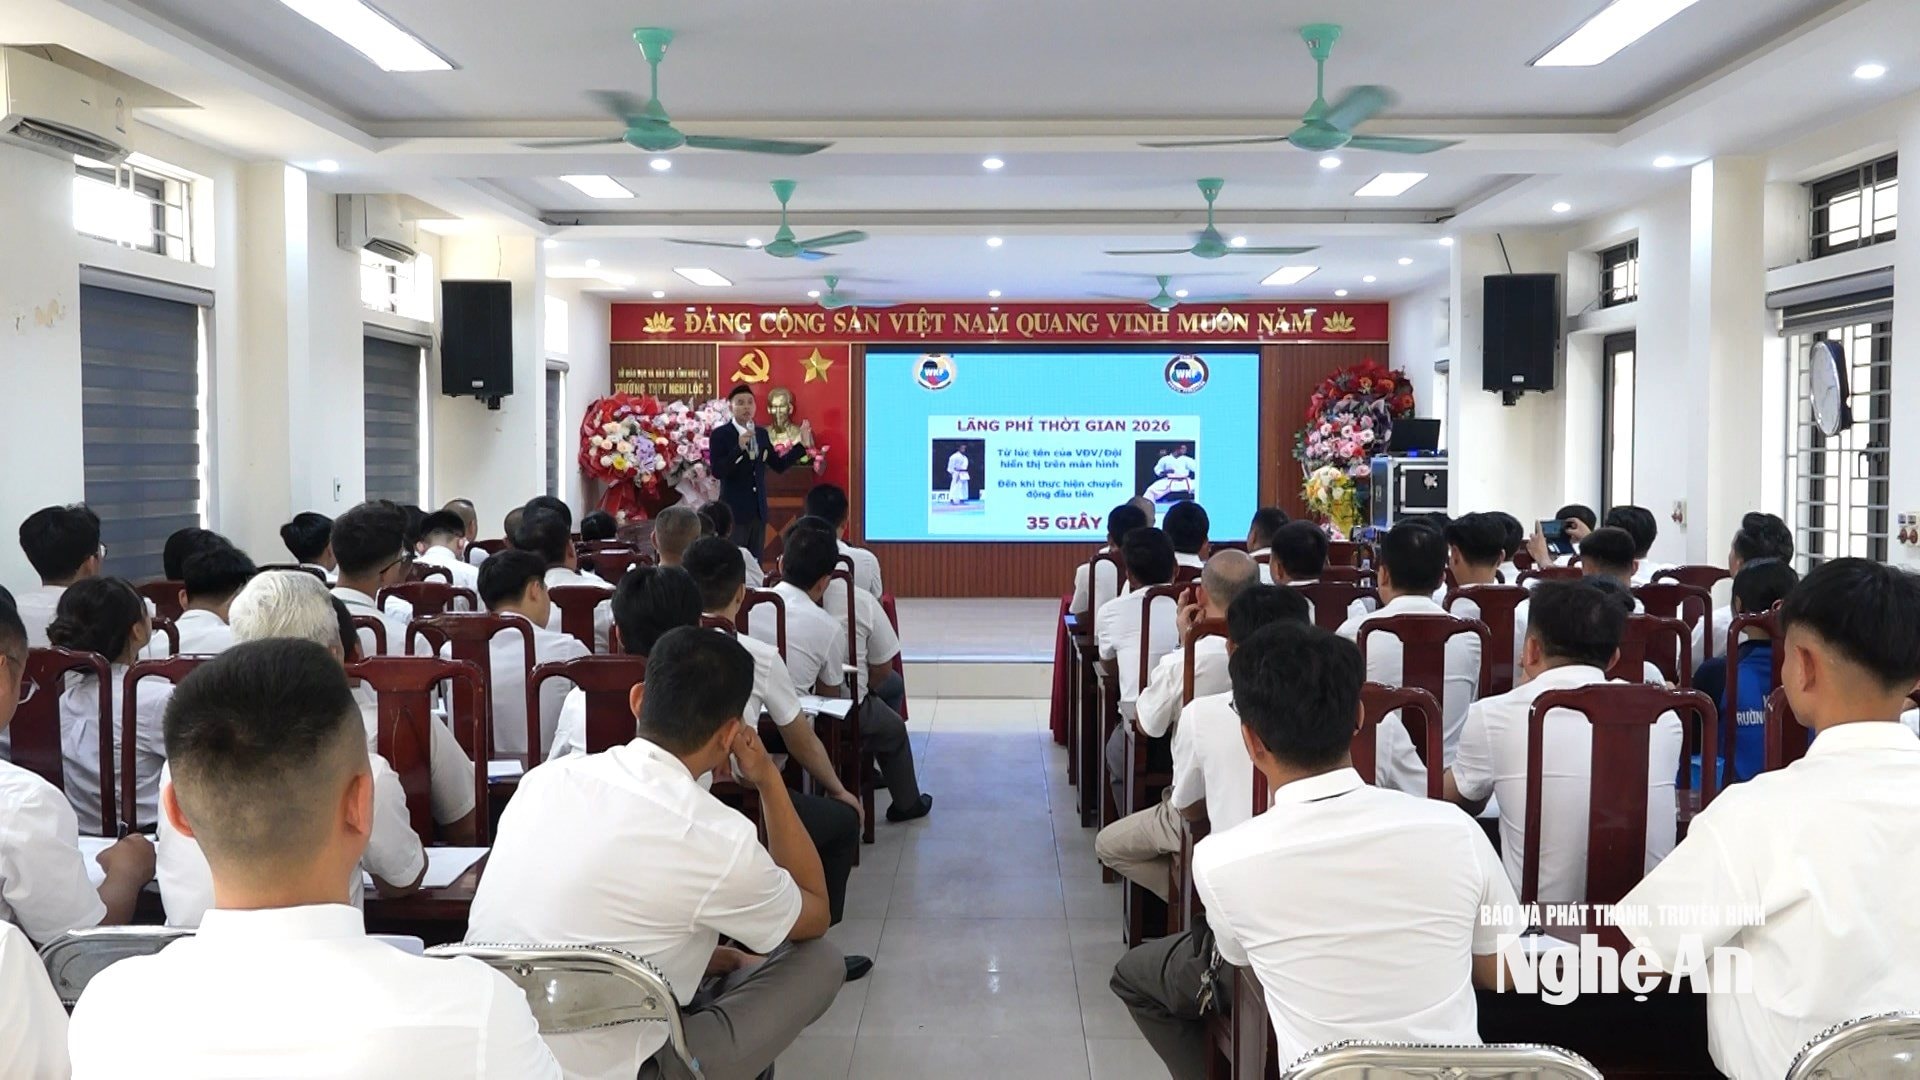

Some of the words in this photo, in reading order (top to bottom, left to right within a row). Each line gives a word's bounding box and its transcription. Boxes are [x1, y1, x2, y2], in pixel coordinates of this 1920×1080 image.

[684, 306, 752, 334] ĐẢNG
[759, 307, 826, 338] CỘNG
[833, 306, 881, 334] SẢN
[888, 307, 946, 338] VIỆT
[953, 313, 1009, 334] NAM
[1016, 313, 1099, 337] QUANG
[1106, 313, 1169, 334] VINH
[1177, 307, 1250, 334] MUÔN
[1257, 307, 1313, 334] NĂM
[648, 383, 667, 395] THPT
[669, 383, 687, 395] NGHI
[688, 381, 704, 398] LỘC
[706, 383, 713, 395] 3
[957, 416, 1000, 432] LÃNG
[1005, 416, 1033, 432] PHÍ
[1039, 416, 1080, 432] THỜI
[1085, 420, 1126, 432] GIAN
[1132, 420, 1171, 432] 2026
[997, 448, 1011, 457] Từ
[1014, 448, 1029, 457] lúc
[1033, 448, 1051, 457] tên
[1053, 448, 1072, 457] của
[1000, 459, 1023, 468] hiển
[1026, 459, 1041, 470] thị
[1044, 459, 1066, 468] trên
[1069, 459, 1092, 468] màn
[1095, 459, 1119, 468] hình
[998, 479, 1017, 488] Đến
[1020, 479, 1035, 488] khi
[1038, 480, 1061, 489] thực
[1063, 479, 1085, 489] hiện
[1087, 479, 1123, 490] chuyển
[1026, 489, 1051, 499] động
[1053, 489, 1072, 498] đầu
[1075, 489, 1094, 498] tiên
[1026, 516, 1049, 530] 35
[1055, 513, 1103, 530] GIÂY
